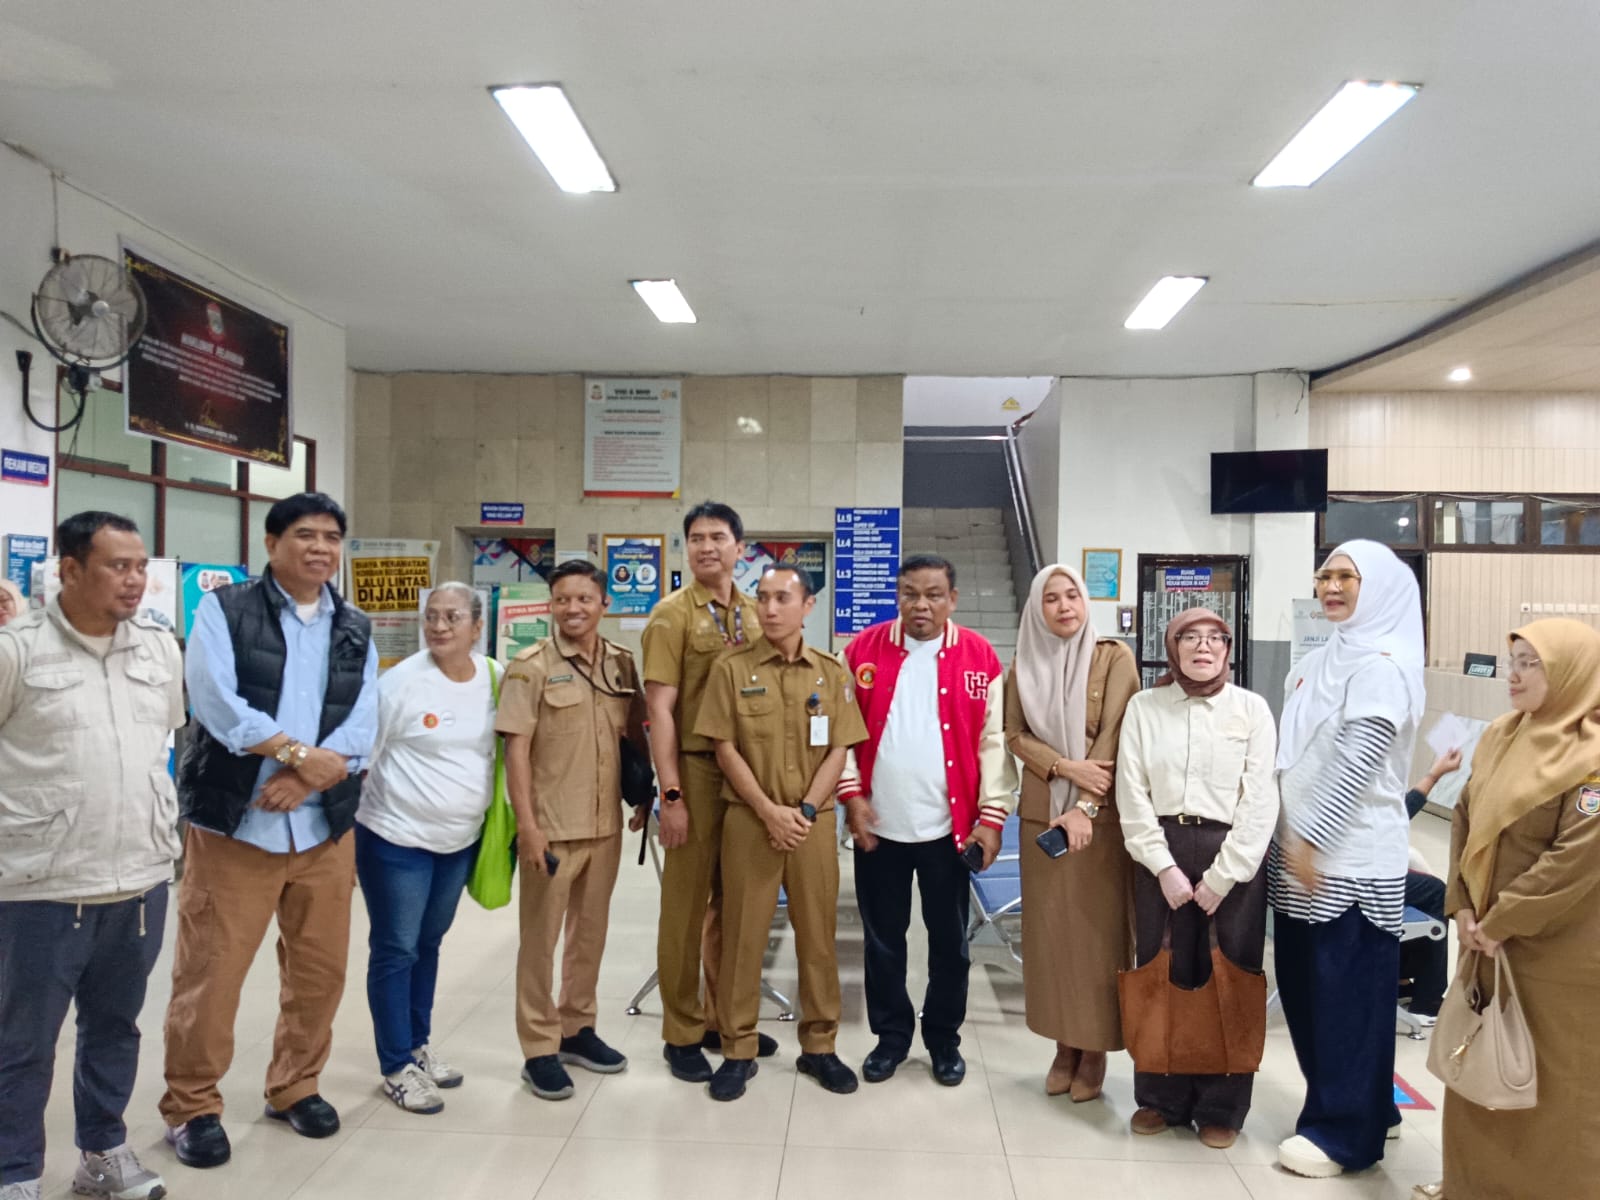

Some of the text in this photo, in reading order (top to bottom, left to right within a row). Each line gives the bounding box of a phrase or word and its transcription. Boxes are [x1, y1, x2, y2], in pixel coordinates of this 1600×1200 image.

[4, 457, 26, 472] REKAM
[837, 539, 851, 547] Lt.4
[380, 559, 427, 567] PERAWATAN
[837, 569, 851, 578] Lt.3
[357, 576, 427, 587] LALU LINTAS
[836, 608, 851, 617] Lt.2
